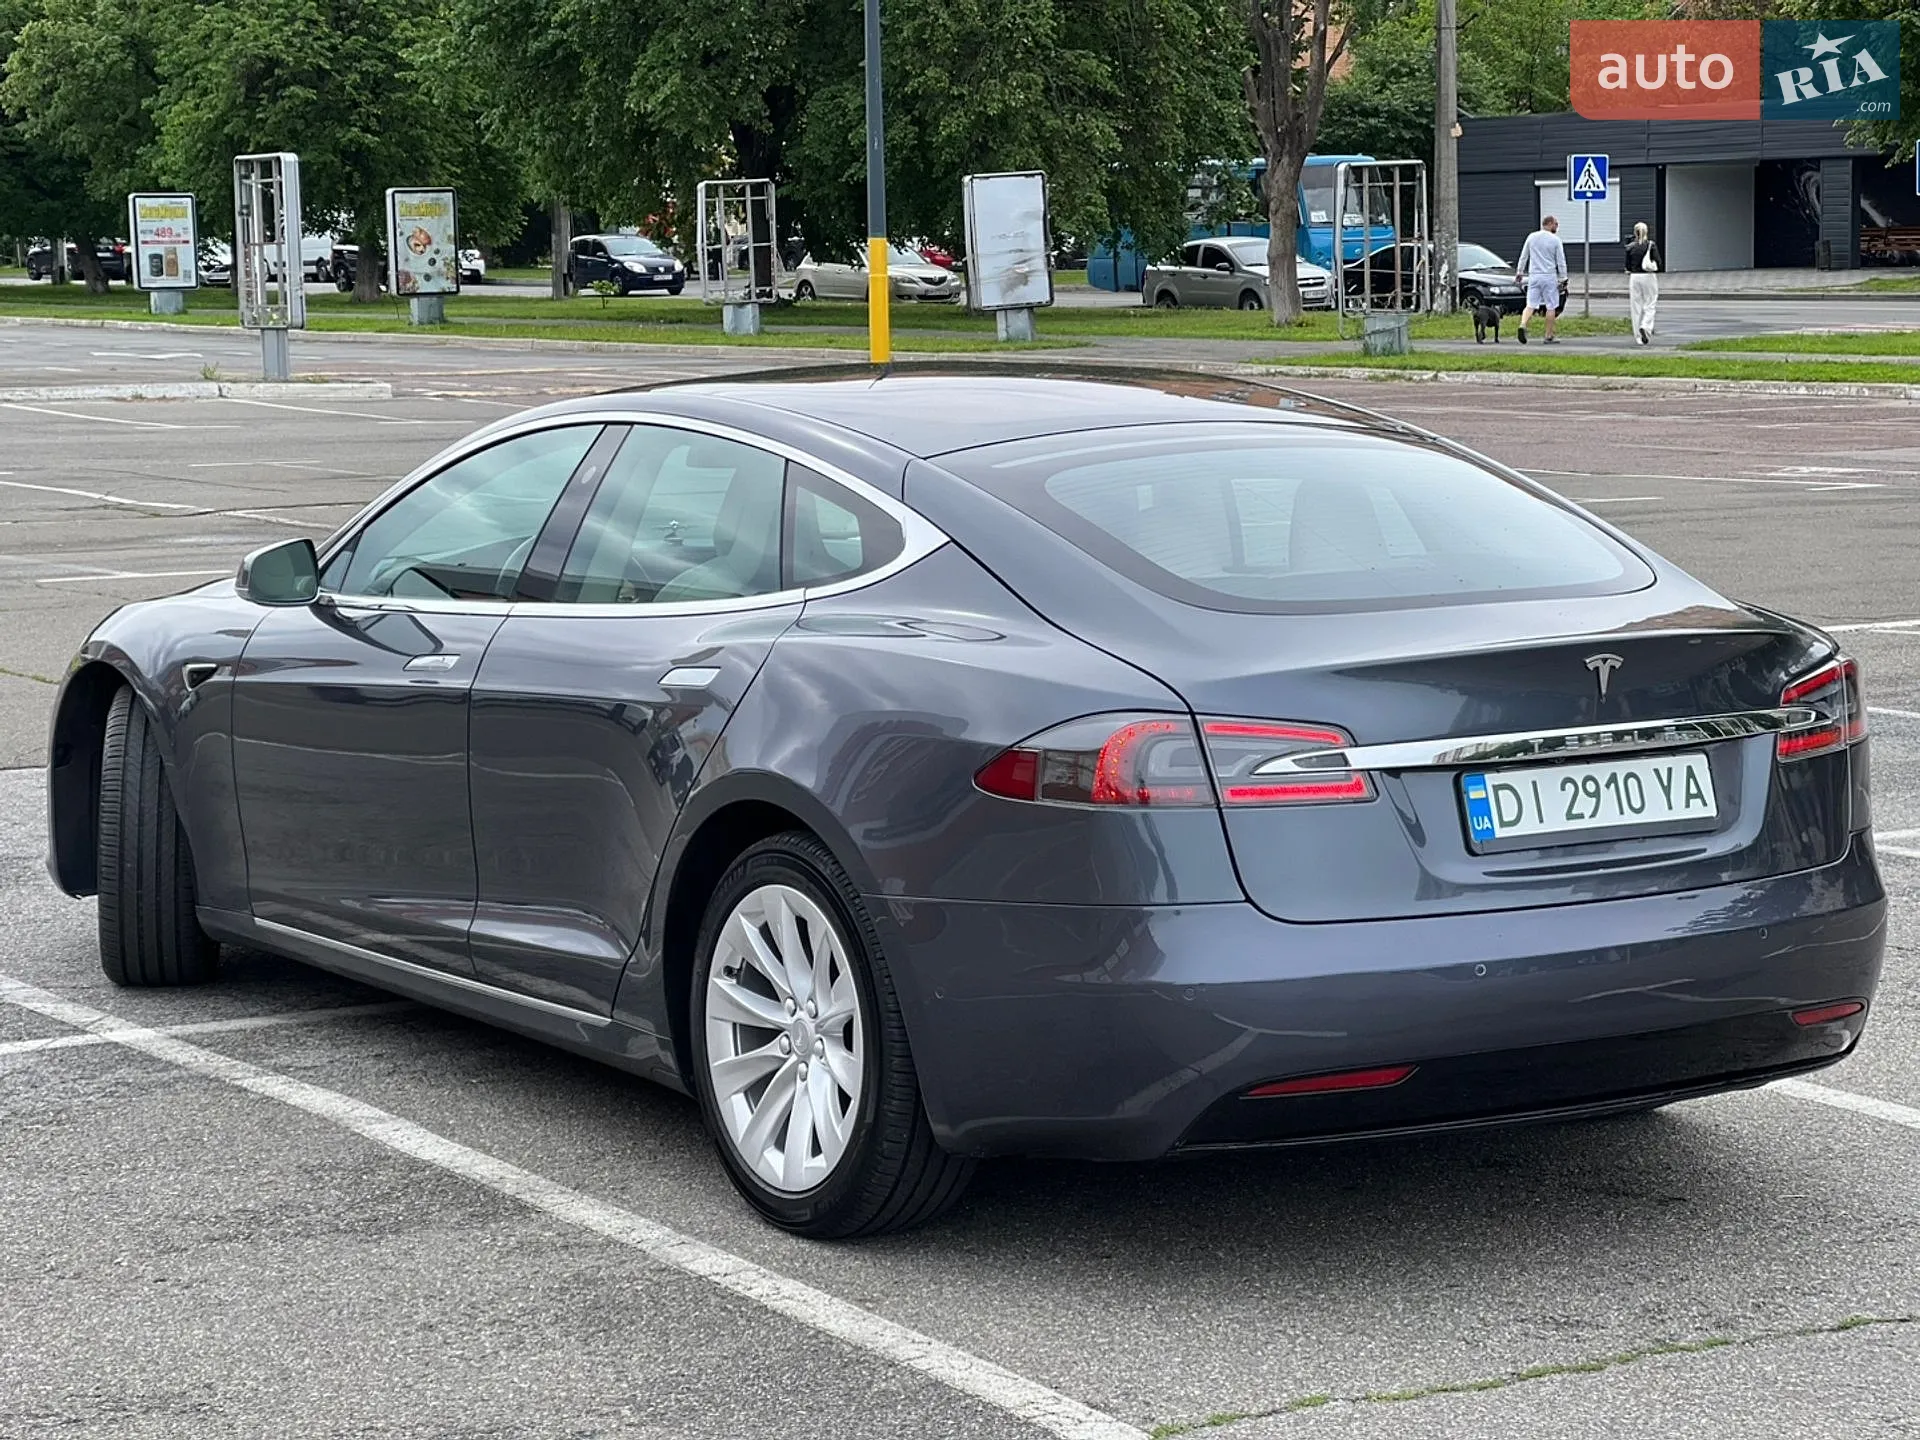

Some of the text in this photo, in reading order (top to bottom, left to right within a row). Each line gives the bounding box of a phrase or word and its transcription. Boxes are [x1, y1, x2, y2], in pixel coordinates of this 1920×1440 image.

[1492, 764, 1708, 829] DI 2910 YA
[1473, 816, 1492, 831] UA
